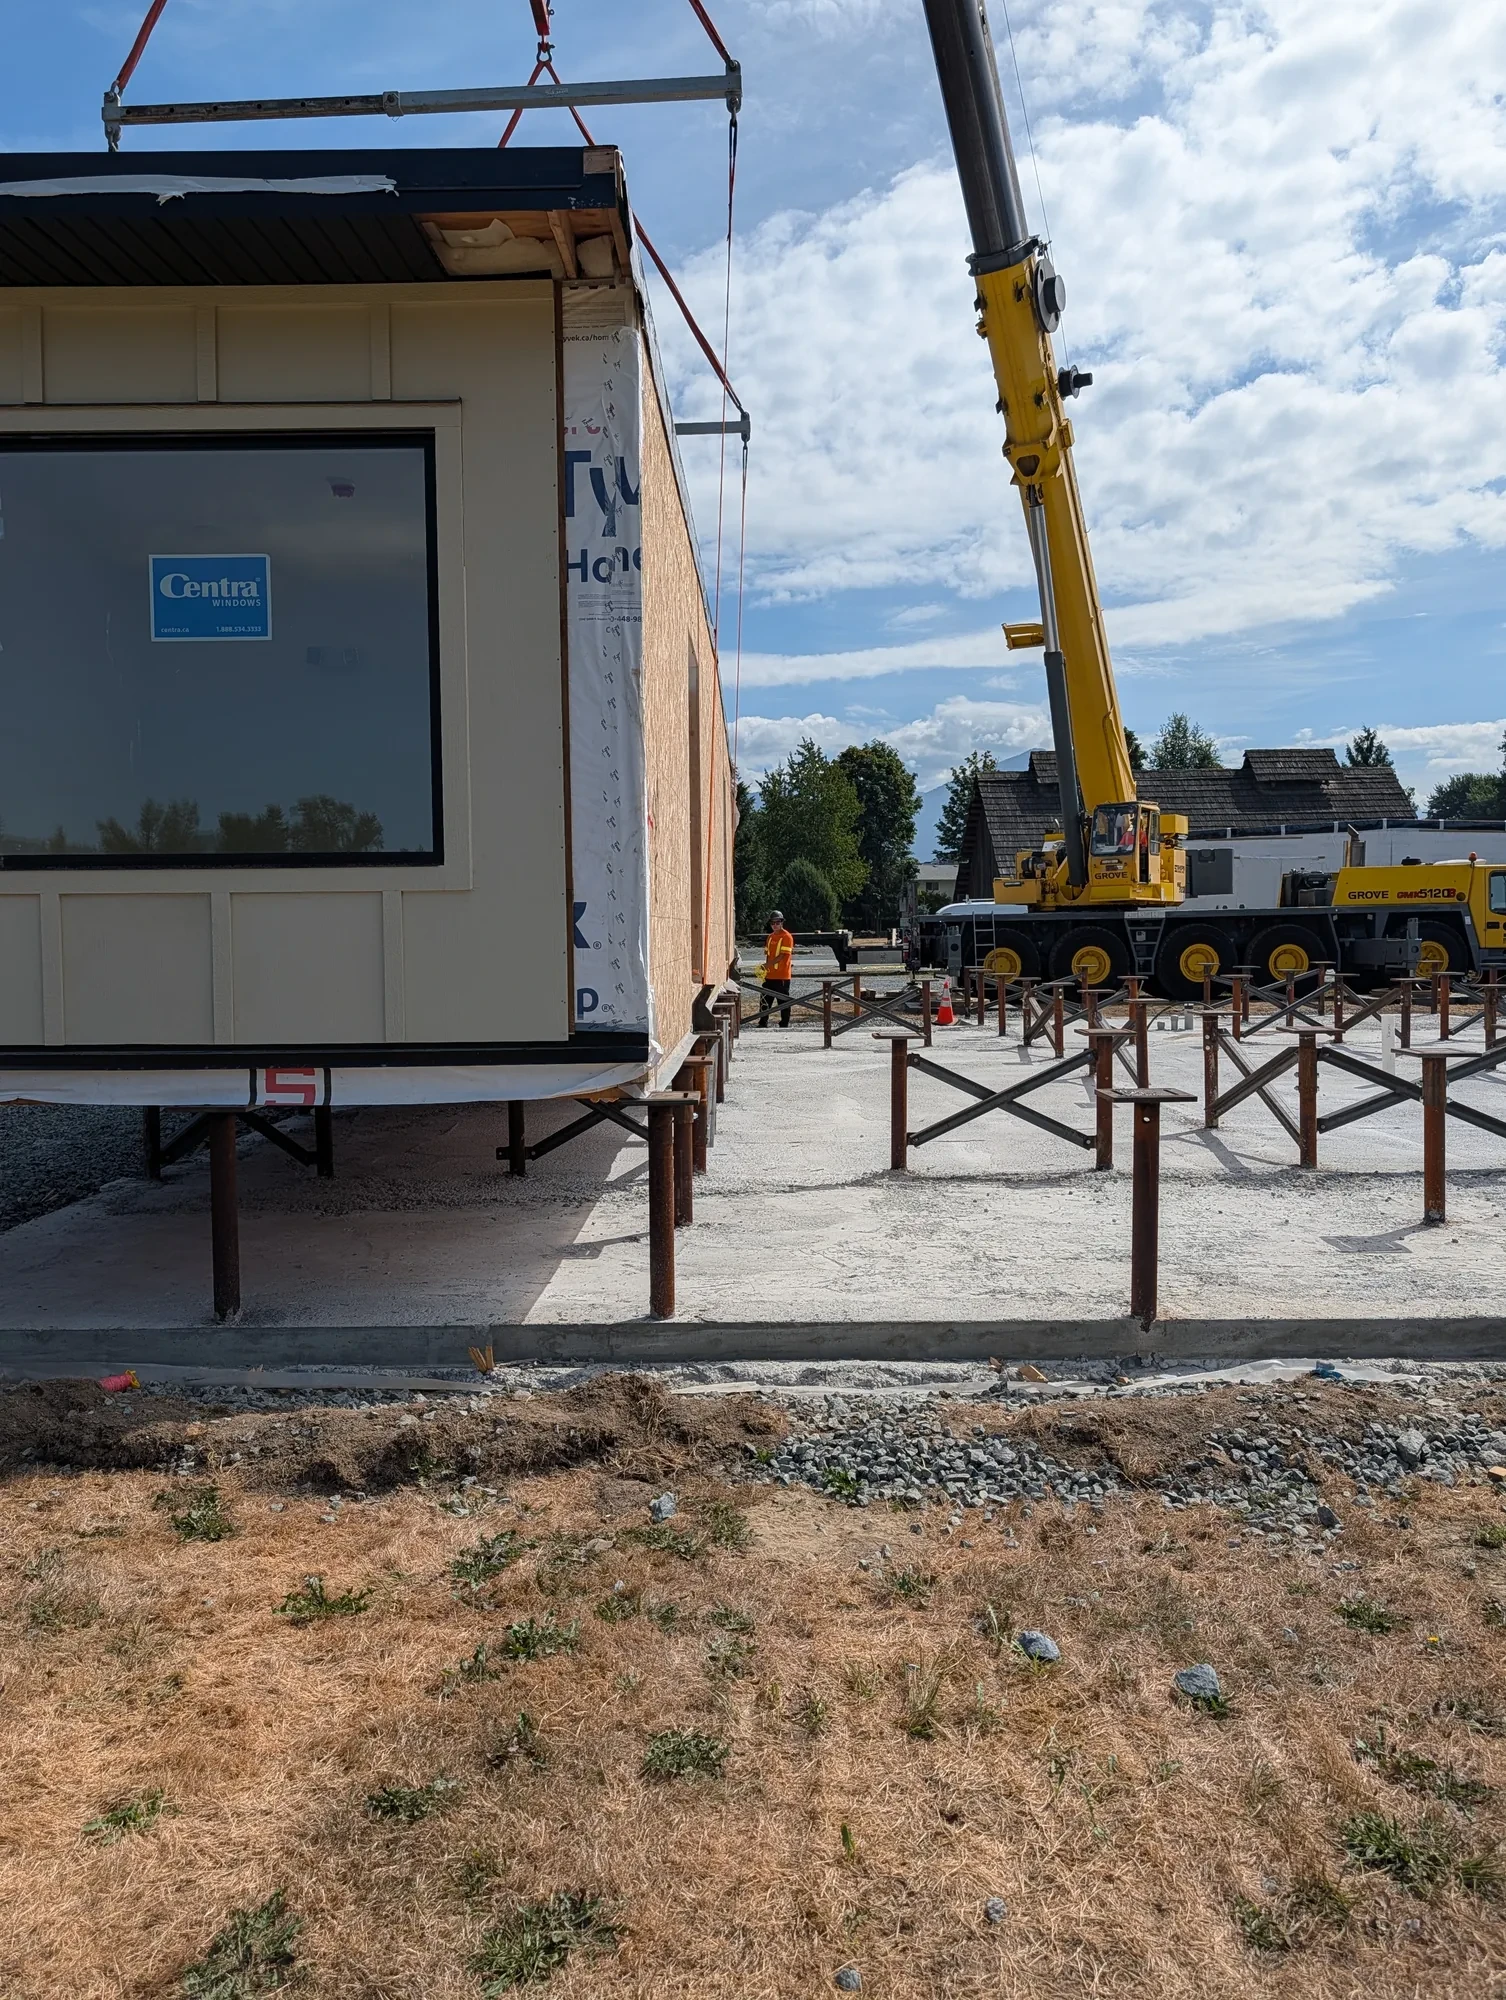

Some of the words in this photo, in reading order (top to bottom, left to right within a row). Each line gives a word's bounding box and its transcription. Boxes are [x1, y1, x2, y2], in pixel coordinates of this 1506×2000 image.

[160, 573, 260, 599] Centra
[212, 599, 261, 607] WINDOWS
[1094, 871, 1128, 880] GROVE
[1348, 890, 1389, 899] GROVE
